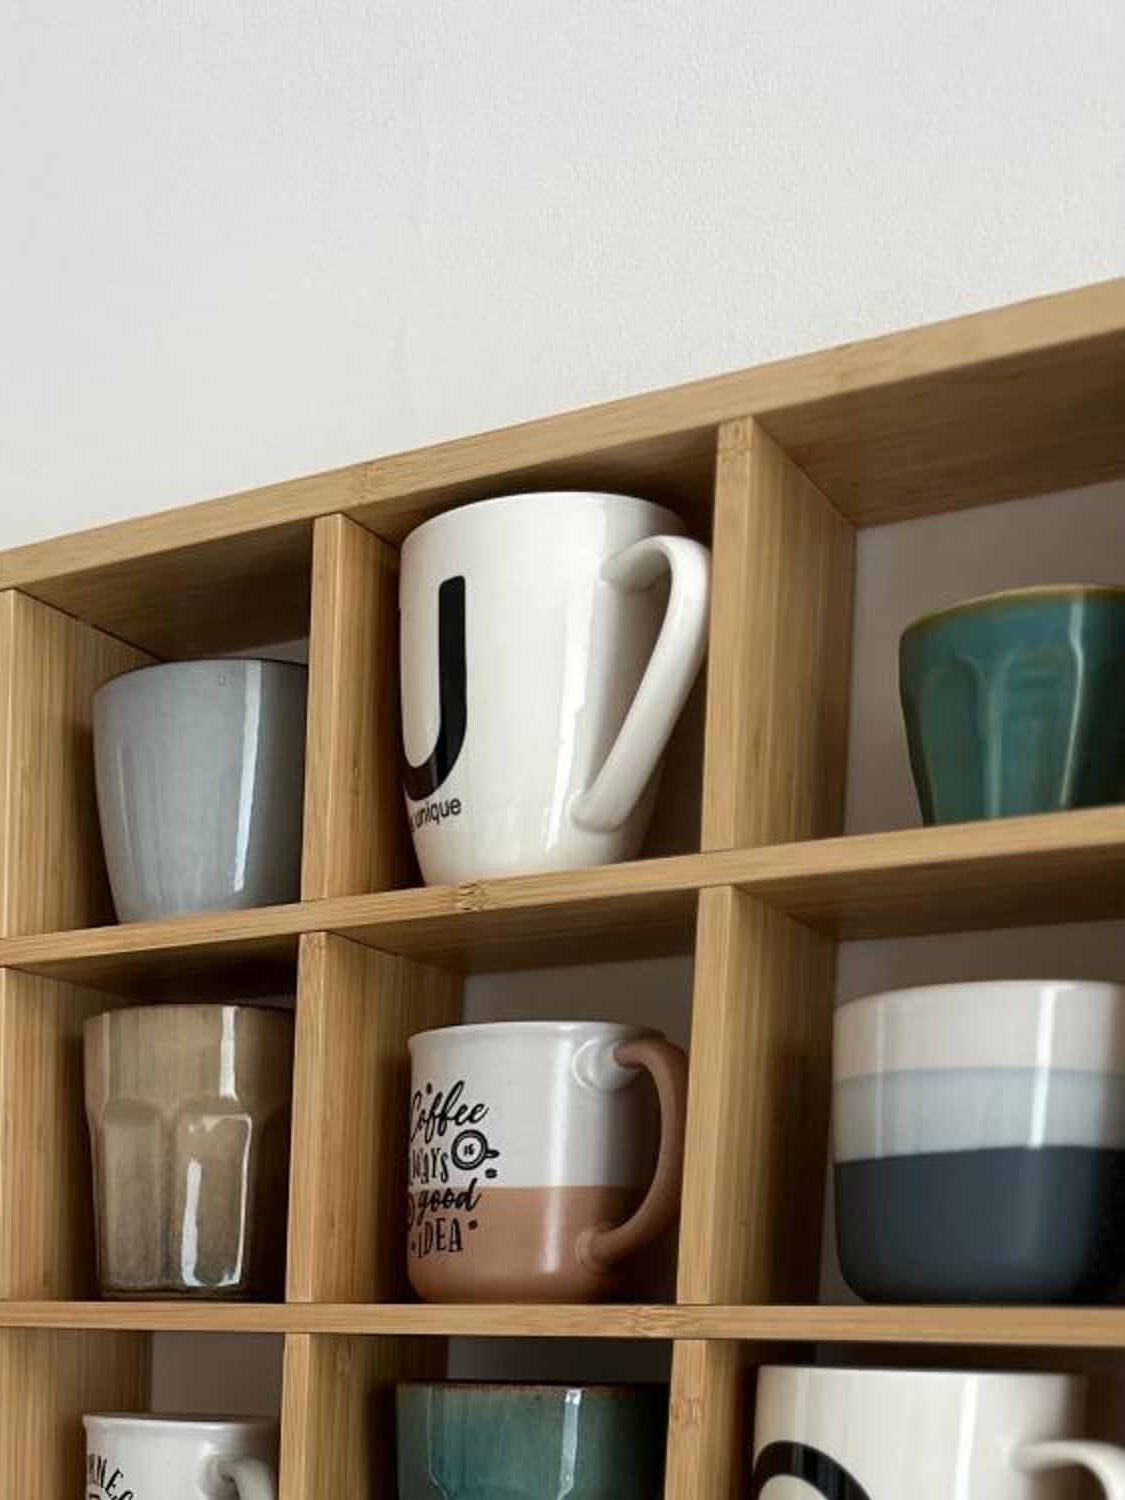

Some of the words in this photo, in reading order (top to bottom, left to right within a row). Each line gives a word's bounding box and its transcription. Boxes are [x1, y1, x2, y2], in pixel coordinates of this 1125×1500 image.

[415, 798, 462, 828] unique
[410, 1080, 489, 1143] Coffee
[417, 1177, 482, 1226] good
[418, 1216, 463, 1258] IDEA
